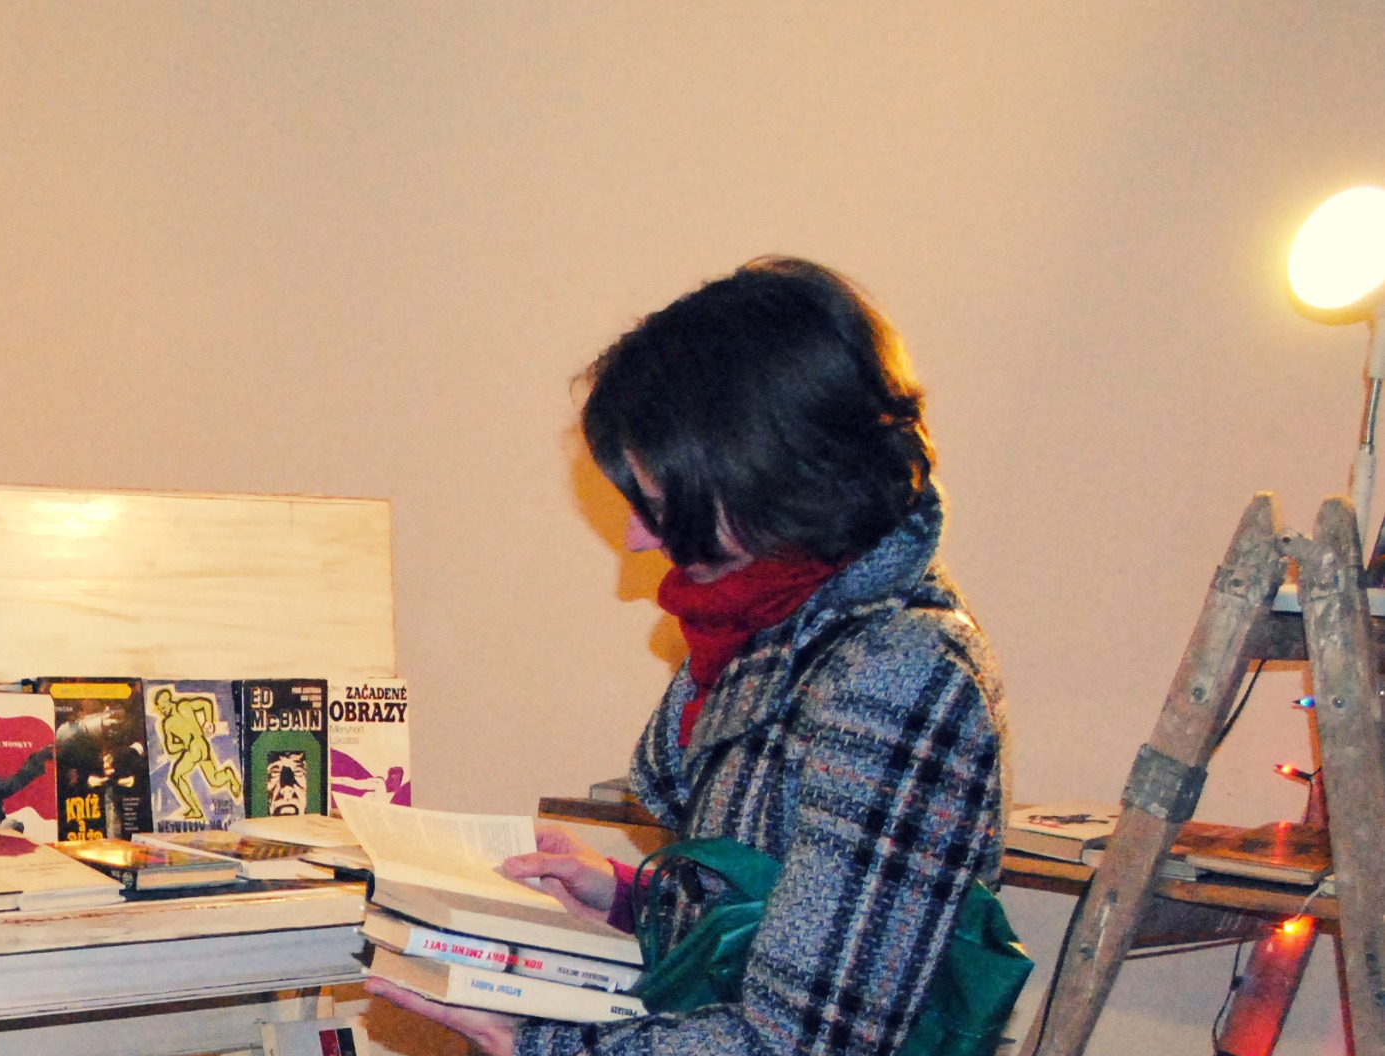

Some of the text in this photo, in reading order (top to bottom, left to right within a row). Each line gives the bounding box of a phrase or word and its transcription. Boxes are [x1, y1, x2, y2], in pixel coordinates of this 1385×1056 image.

[251, 687, 274, 709] ED
[345, 684, 408, 700] ZAČADENÉ
[329, 700, 408, 722] OBRAZY
